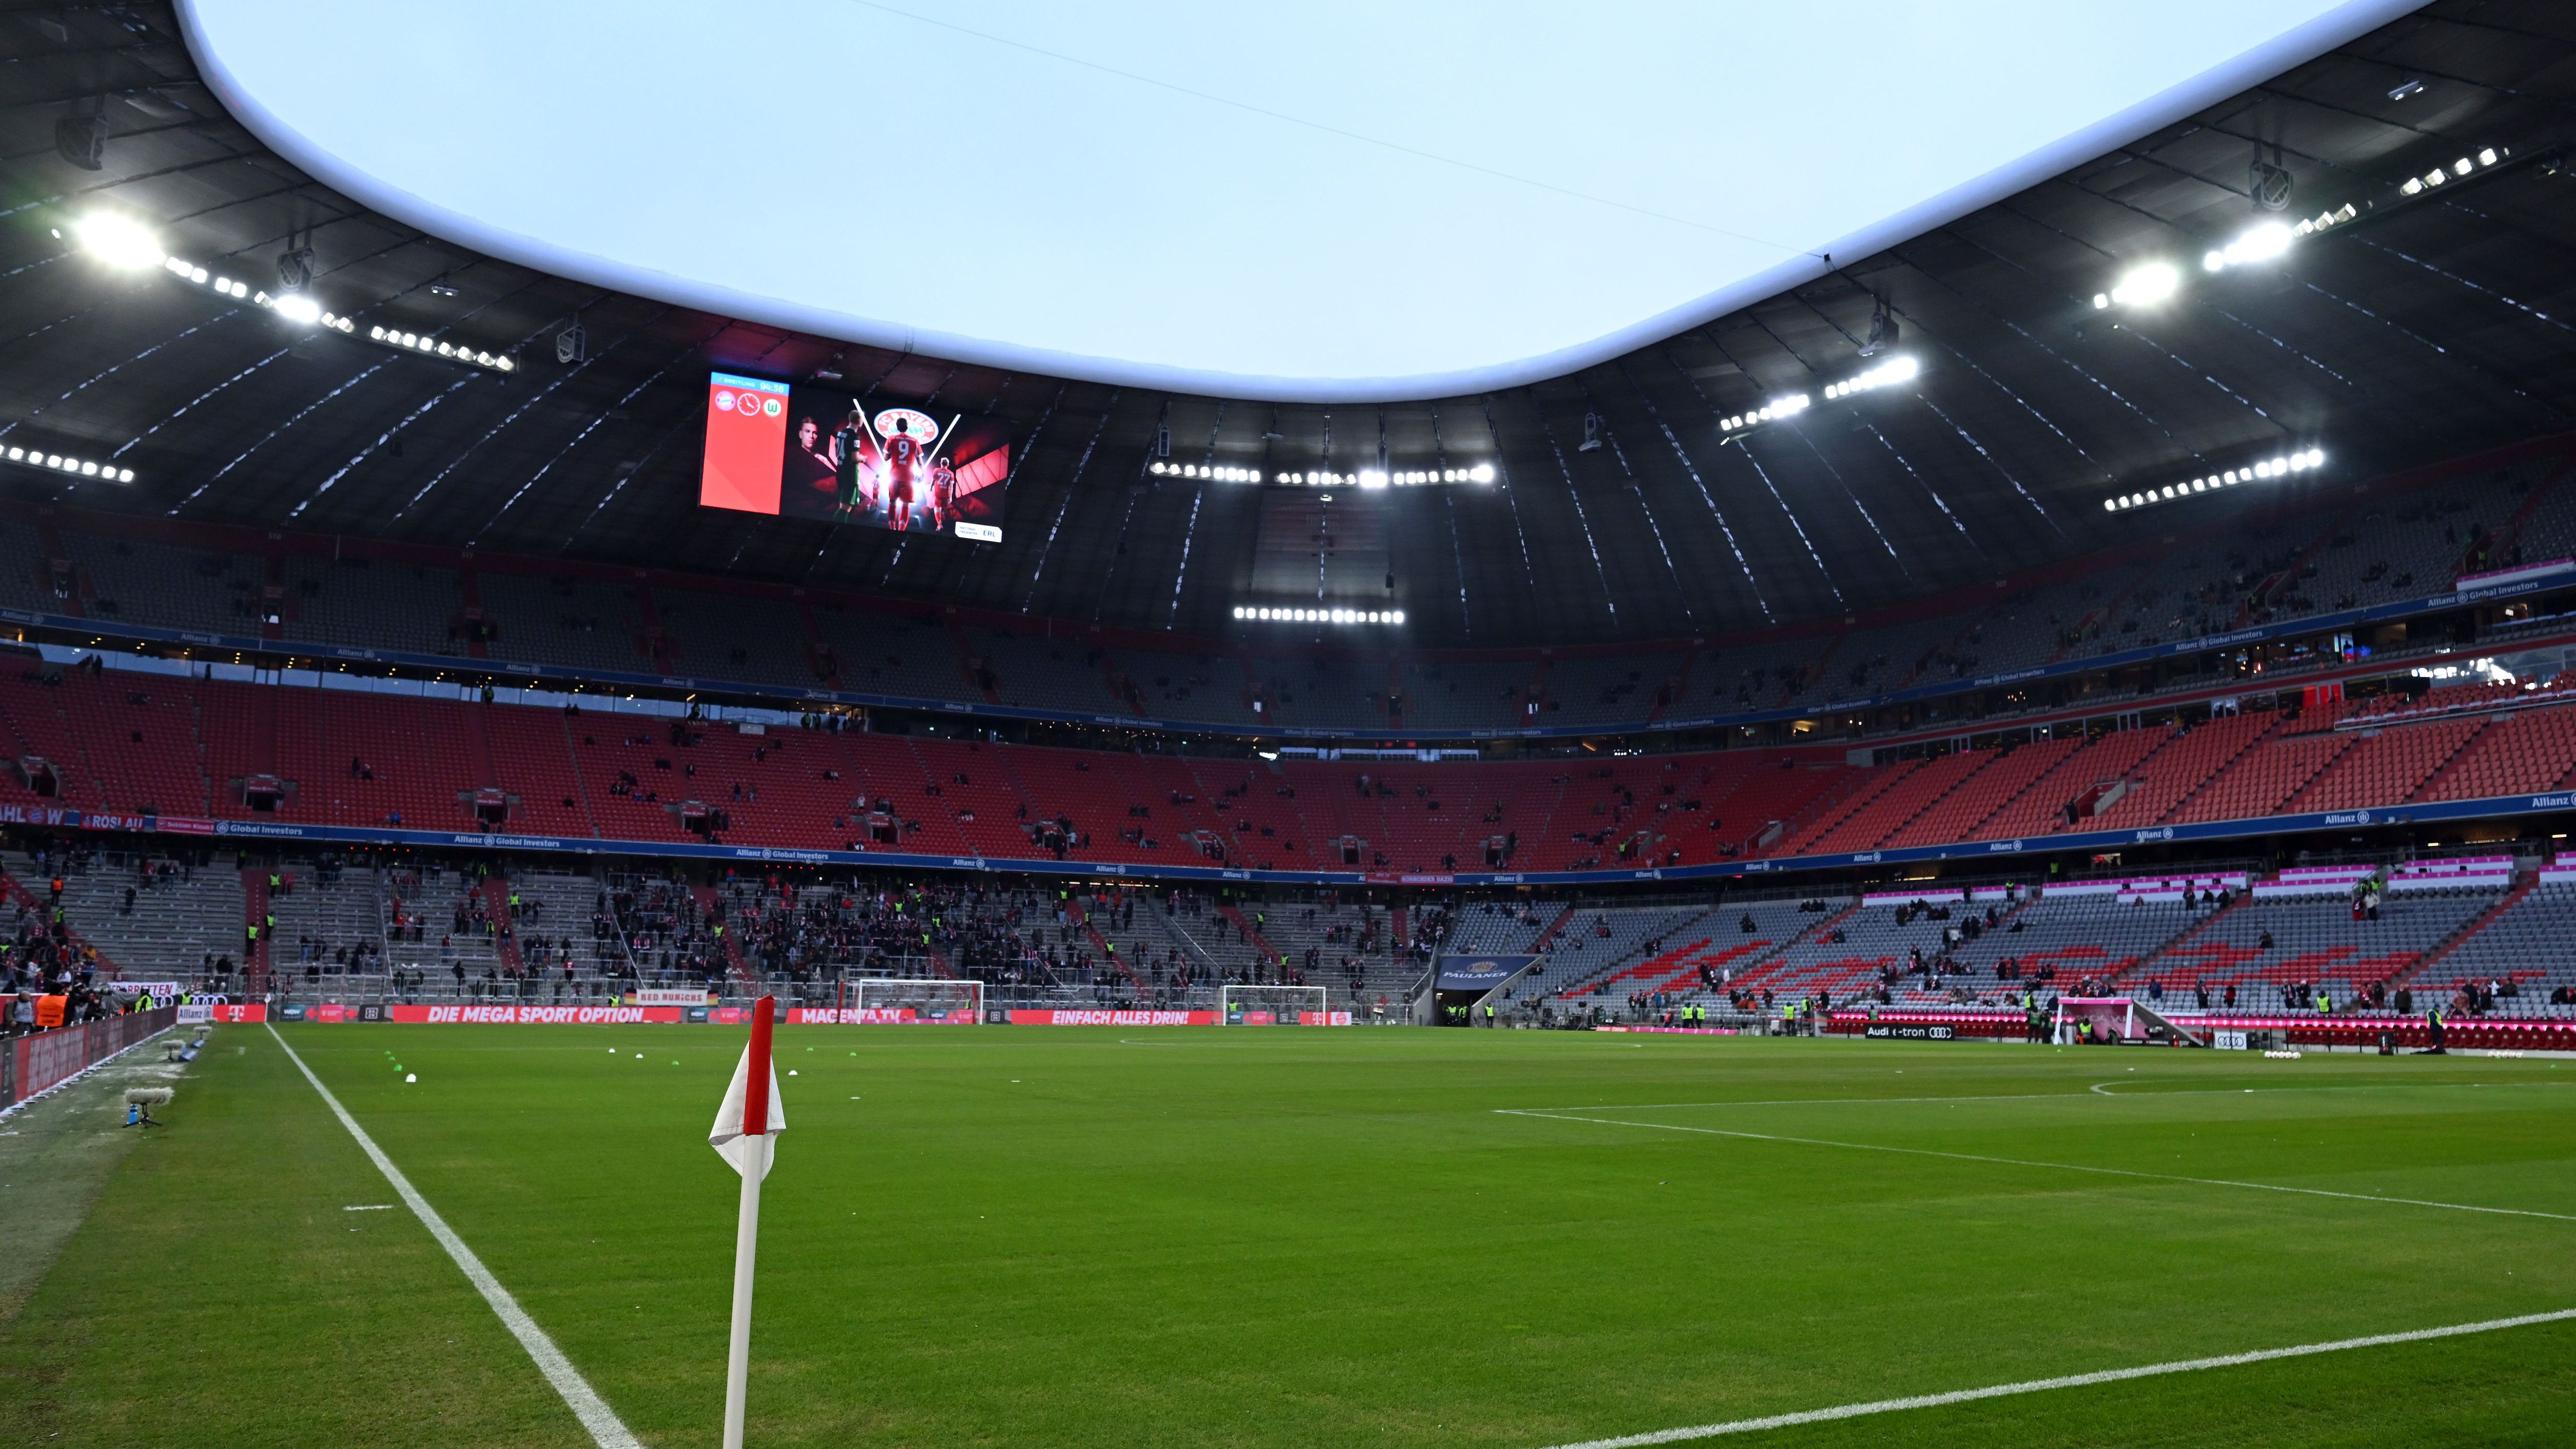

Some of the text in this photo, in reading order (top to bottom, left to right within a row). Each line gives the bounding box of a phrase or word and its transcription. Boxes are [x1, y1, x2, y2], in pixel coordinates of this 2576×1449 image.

[724, 378, 755, 387] BREITLING
[899, 440, 909, 459] 9
[938, 472, 951, 485] 27
[2428, 581, 2539, 608] Allianz Global Investors
[2176, 630, 2263, 651] Allianz Global Investors
[2532, 797, 2569, 807] Allianz
[2325, 814, 2355, 825] Allianz
[230, 825, 303, 835] Global Investors
[2137, 831, 2162, 839] Allianz
[455, 835, 482, 844] Allianz
[496, 837, 521, 846] Global
[1990, 843, 2012, 851] Allianz
[179, 1009, 203, 1019] Allianz
[428, 1006, 645, 1024] DIE MEGA SPORT OPTION
[1052, 1010, 1189, 1025] EINFACH ALLES DRIN!
[1868, 1027, 1889, 1036] Audi
